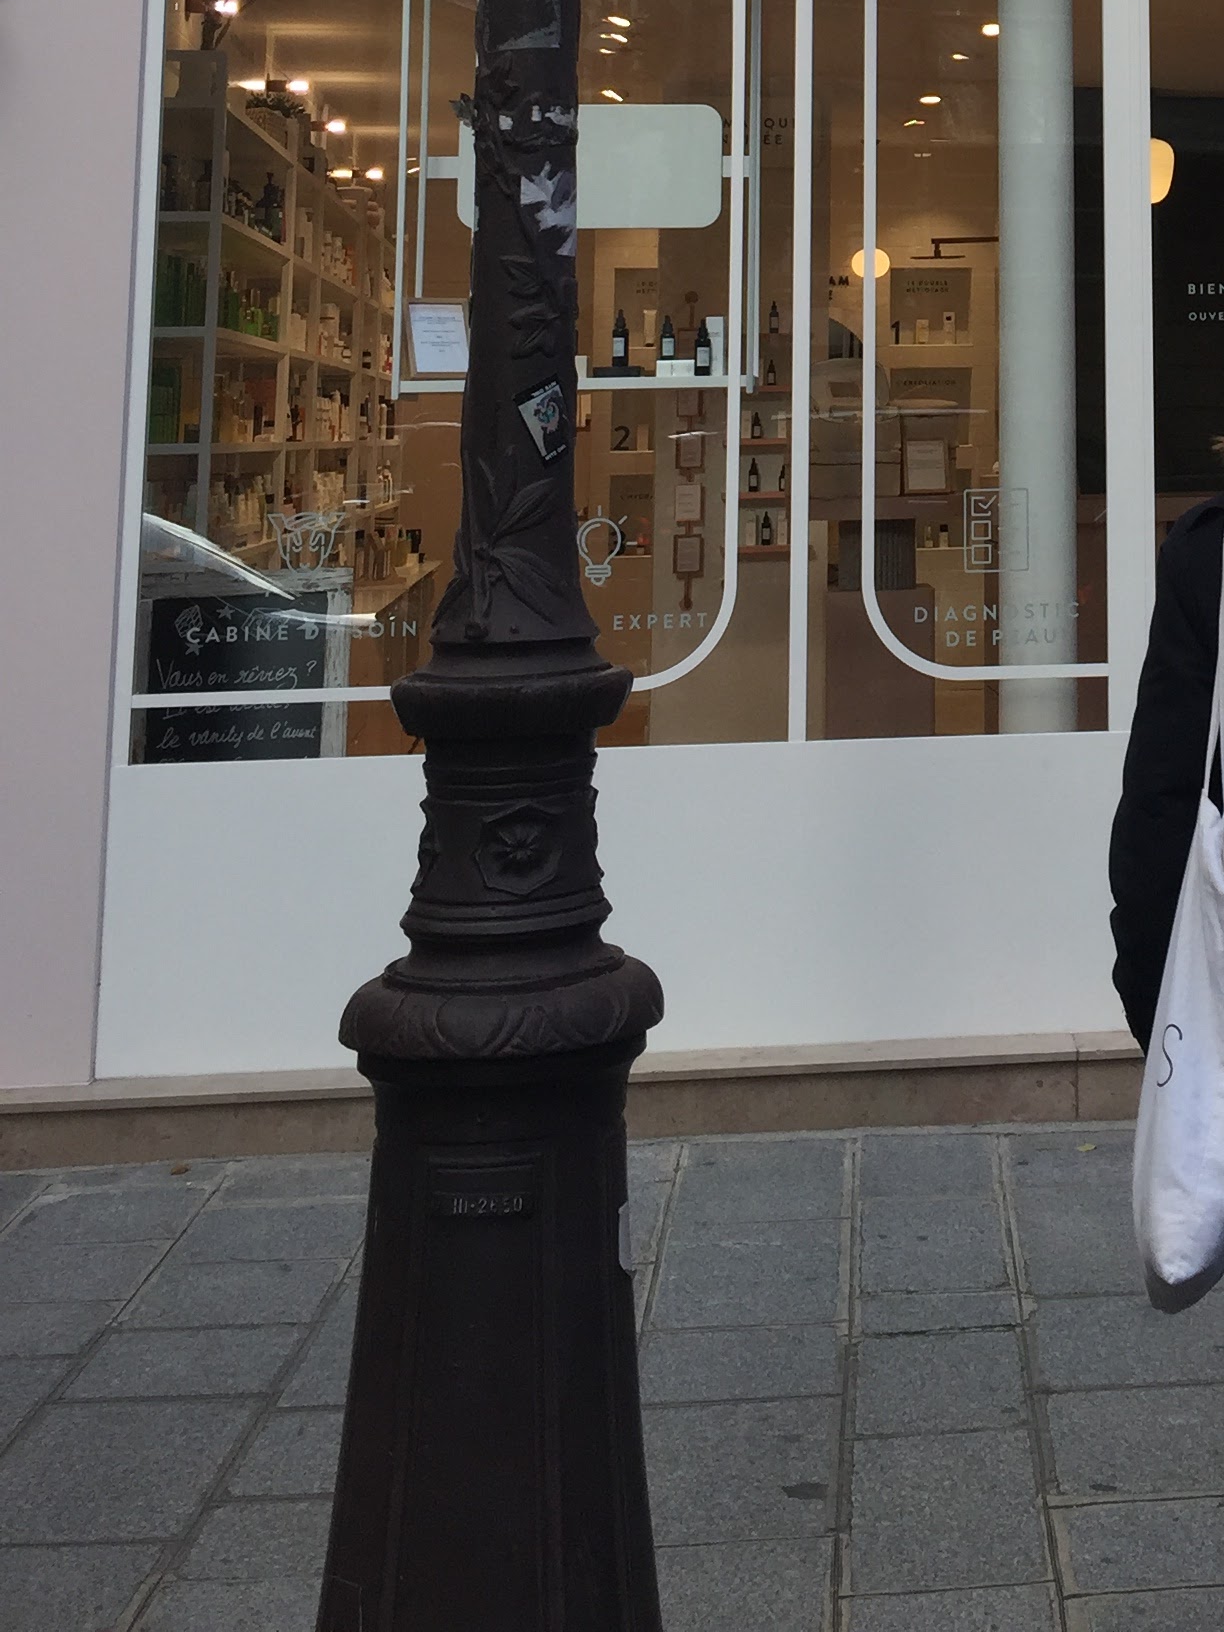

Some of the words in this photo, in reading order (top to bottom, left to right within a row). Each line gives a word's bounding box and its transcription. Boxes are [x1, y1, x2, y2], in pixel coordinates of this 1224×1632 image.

[613, 425, 630, 451] 2
[613, 612, 708, 630] EXPERT
[186, 624, 289, 643] CABINE
[946, 630, 977, 647] DE
[207, 672, 229, 686] en
[247, 724, 264, 741] de
